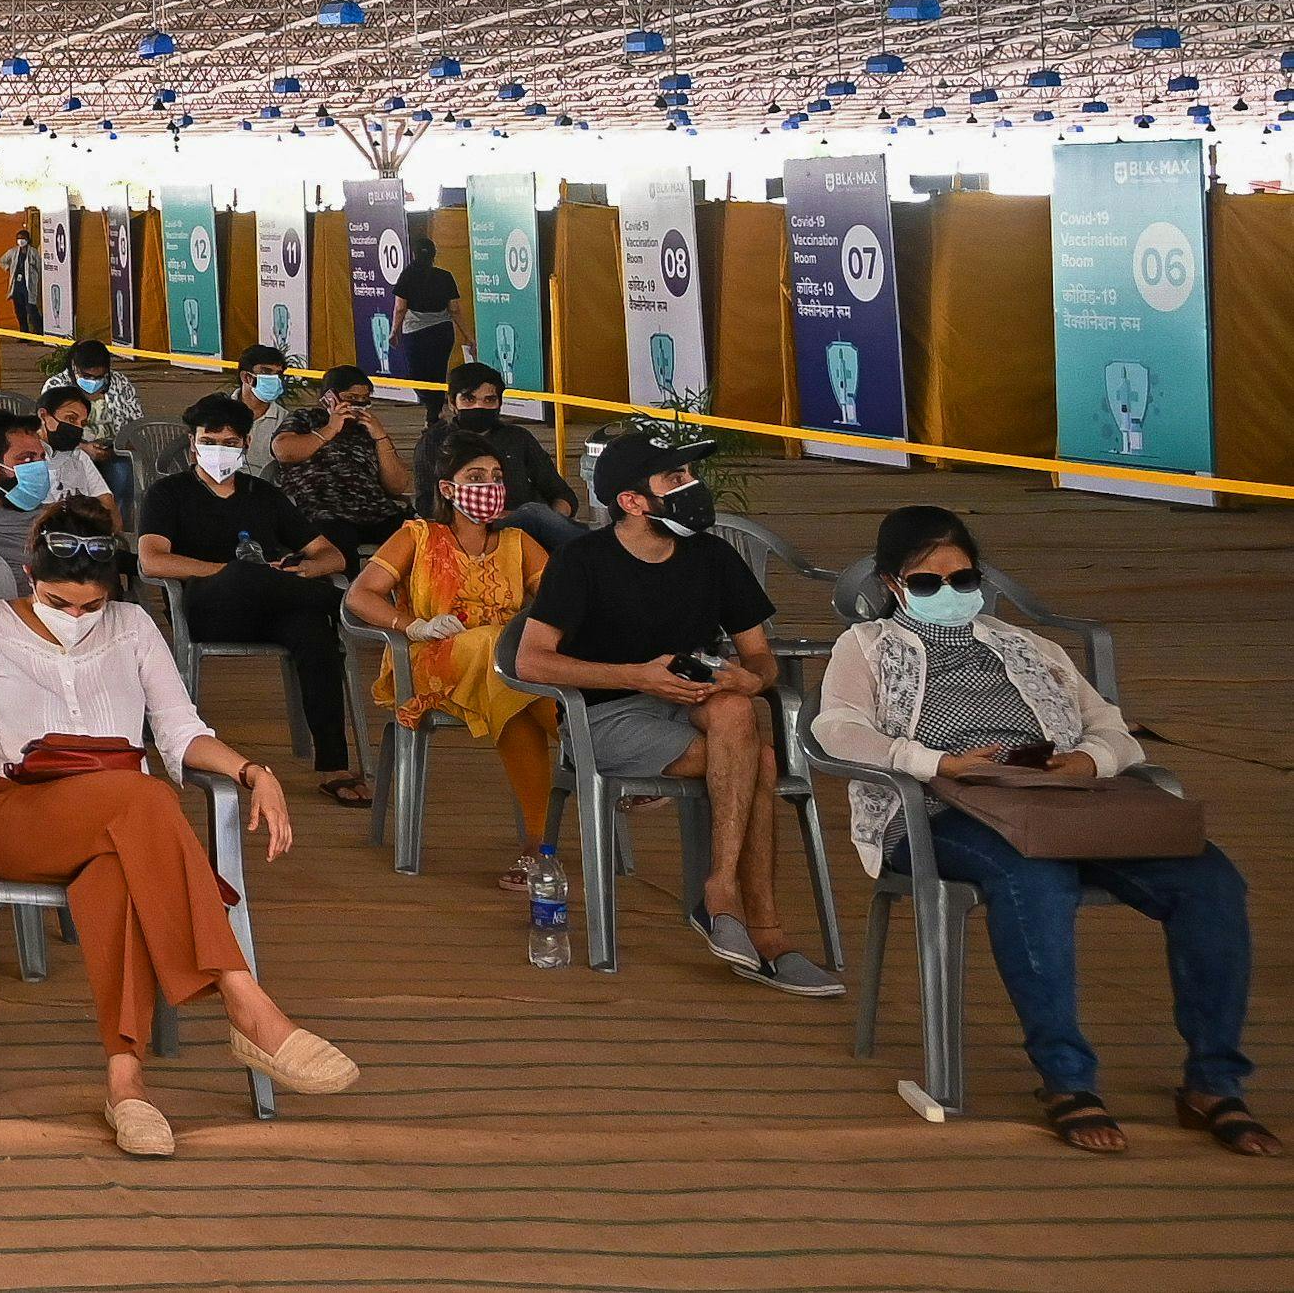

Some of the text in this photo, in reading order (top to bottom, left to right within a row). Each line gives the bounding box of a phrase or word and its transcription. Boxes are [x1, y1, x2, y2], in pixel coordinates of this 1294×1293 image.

[1129, 160, 1191, 176] BLK-MAX
[835, 171, 877, 185] BLK-MAX
[624, 220, 649, 231] Covid-19
[791, 215, 825, 228] Covid-19
[1060, 211, 1109, 226] Covid-19
[57, 234, 65, 253] 14
[625, 237, 659, 248] Vaccination
[792, 233, 838, 246] Vaccination
[1060, 232, 1127, 247] Vaccination
[194, 239, 208, 259] 12
[286, 241, 297, 264] 11
[383, 245, 399, 269] 10
[508, 246, 529, 273] 09
[626, 253, 643, 264] Room
[664, 248, 687, 278] 08
[794, 252, 817, 264] Room
[848, 247, 876, 280] 07
[1061, 254, 1094, 268] Room
[1142, 248, 1187, 286] 06
